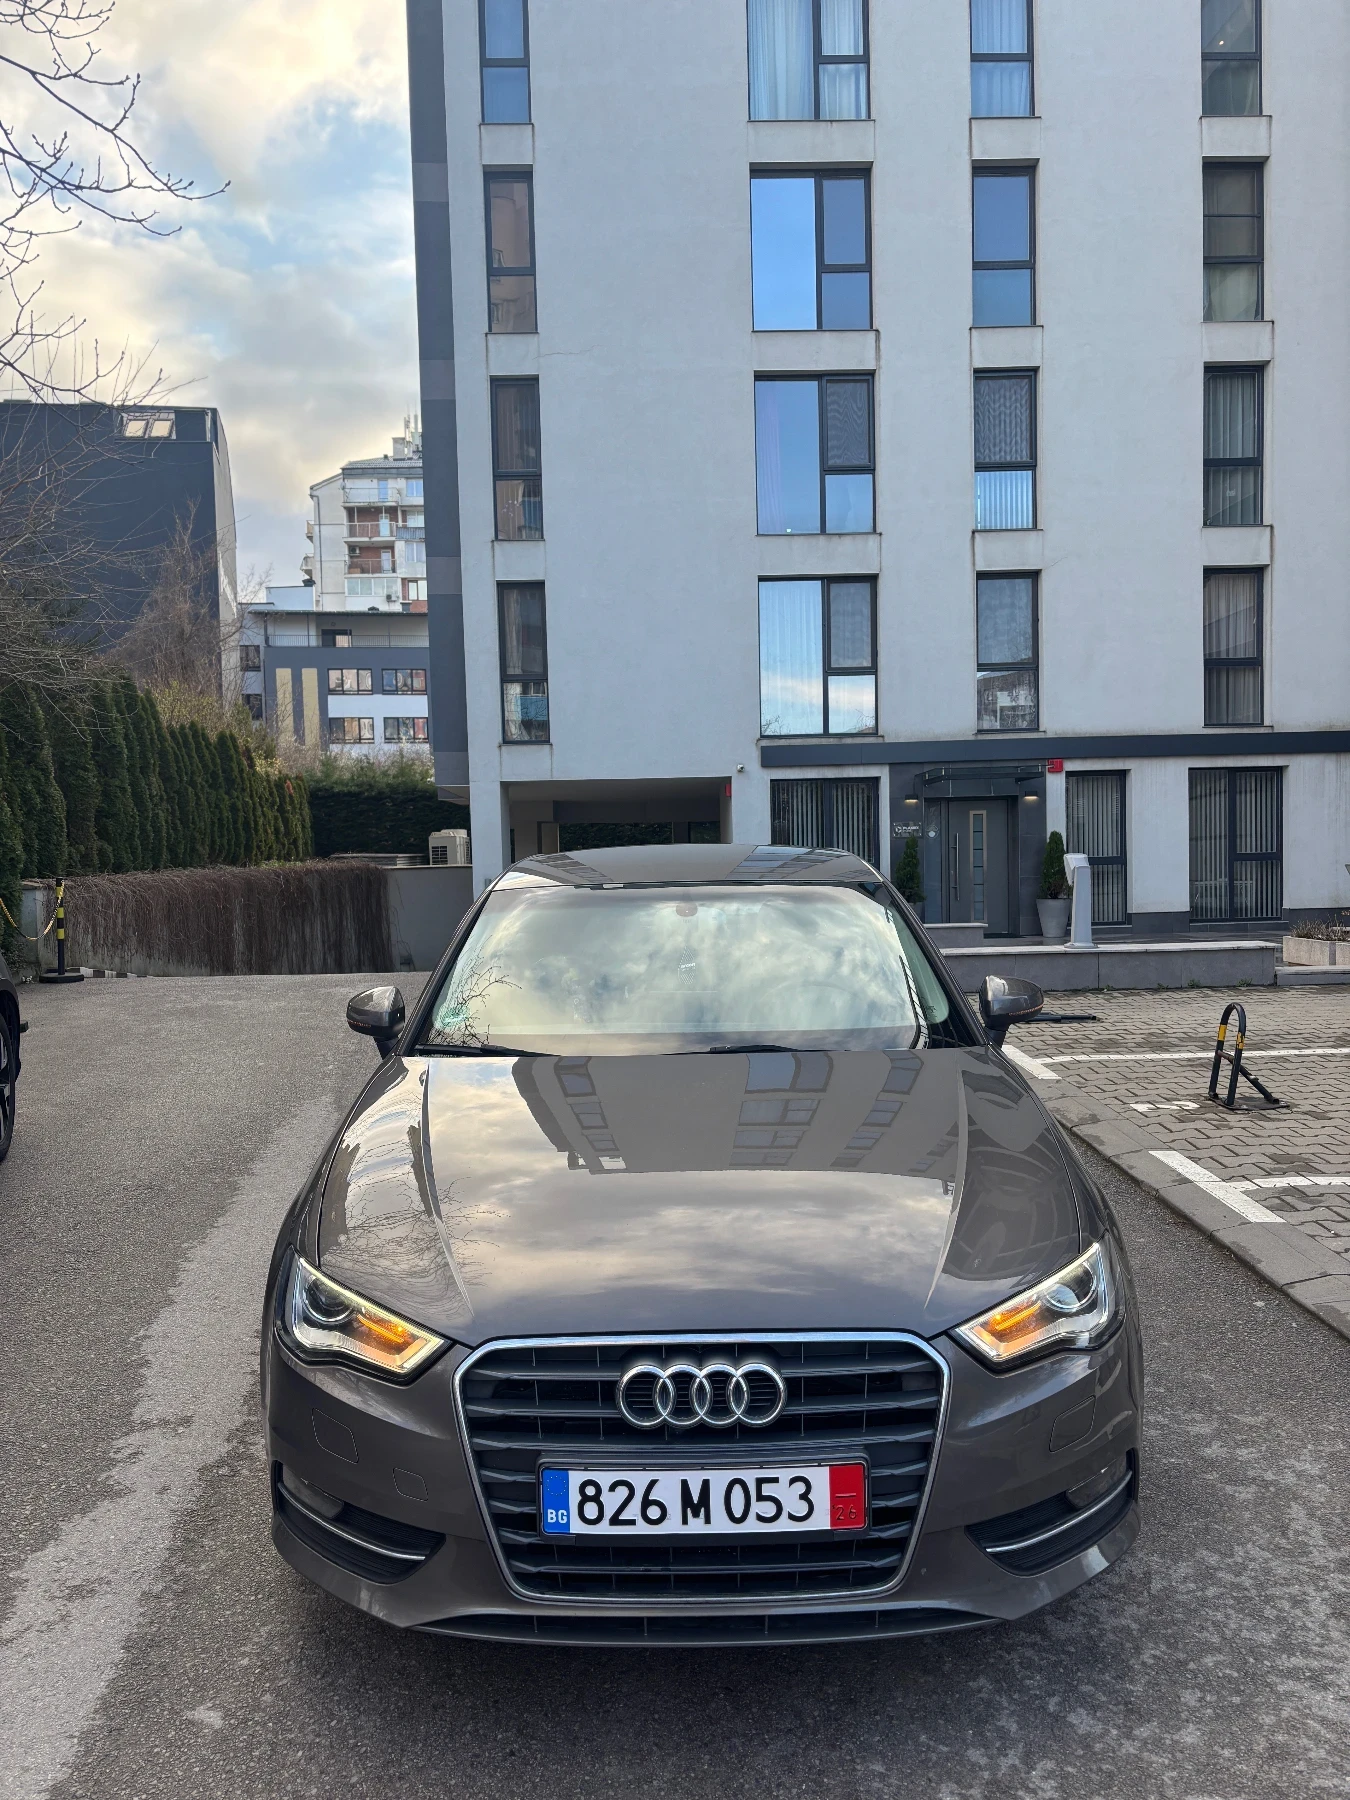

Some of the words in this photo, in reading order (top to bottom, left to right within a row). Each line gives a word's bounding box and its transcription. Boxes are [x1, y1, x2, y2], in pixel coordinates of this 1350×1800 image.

[547, 1508, 567, 1524] BG
[577, 1478, 668, 1526] 826
[681, 1478, 712, 1525] M
[724, 1475, 815, 1525] 053
